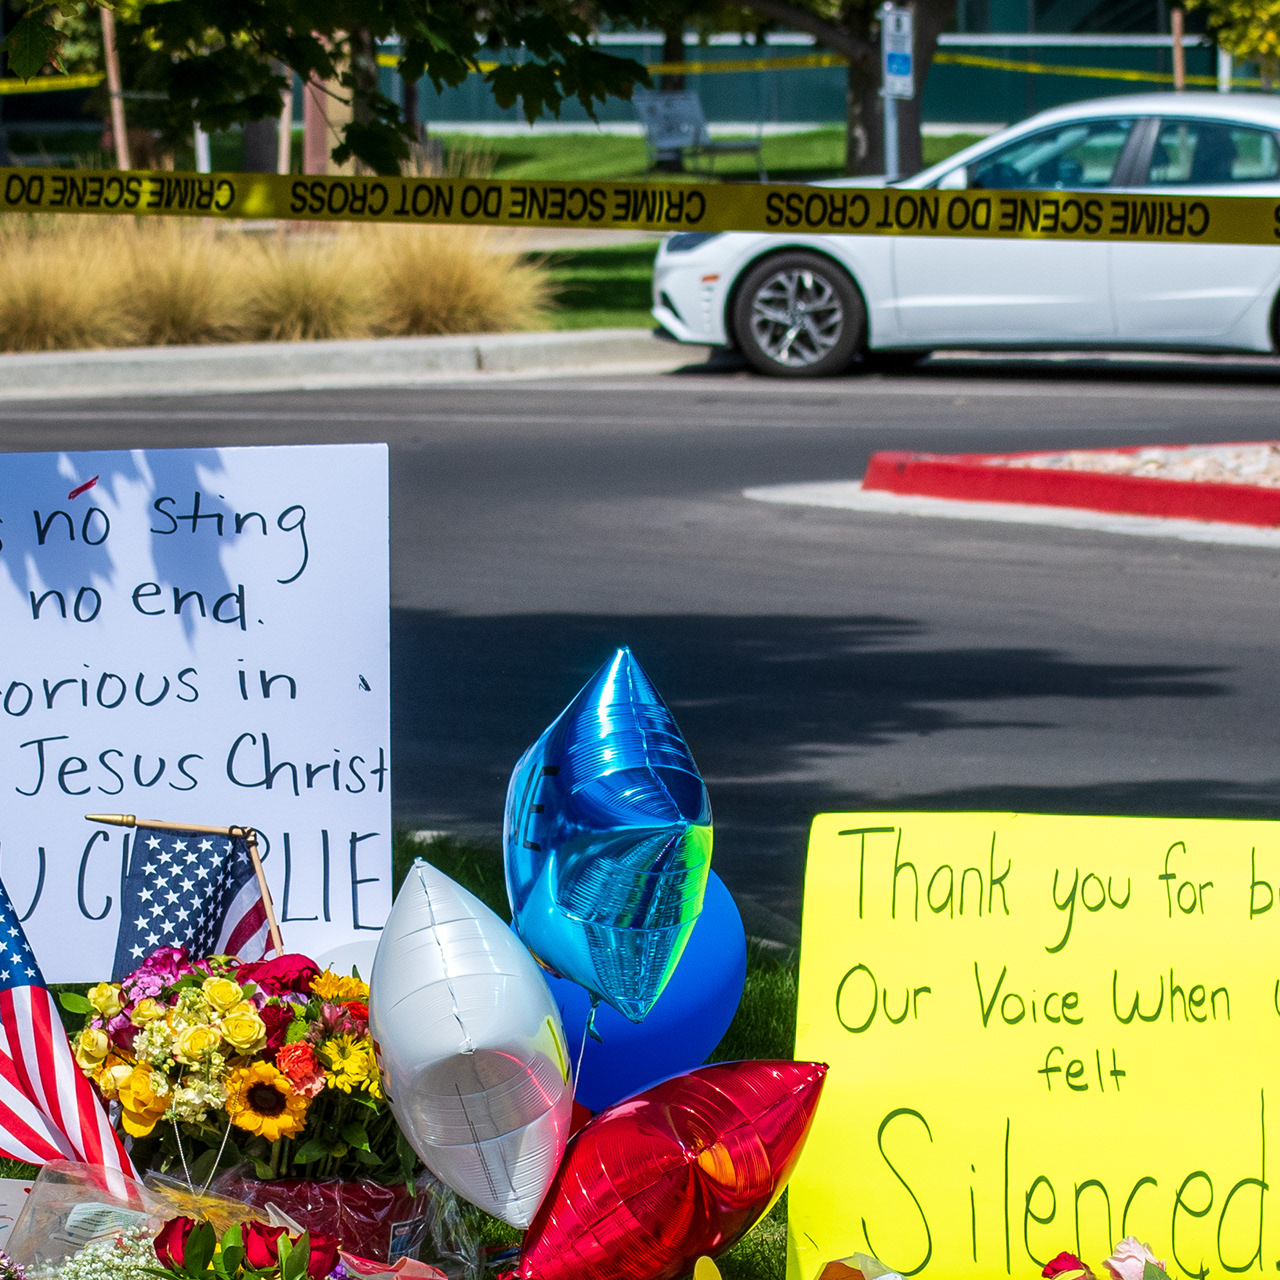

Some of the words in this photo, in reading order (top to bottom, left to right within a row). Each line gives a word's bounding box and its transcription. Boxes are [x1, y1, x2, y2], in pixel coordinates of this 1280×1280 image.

[5, 174, 44, 206] DO
[52, 176, 140, 207] SCENE
[142, 179, 235, 210] CRIME
[290, 181, 388, 215] CROSS
[394, 184, 453, 216] NOT
[461, 185, 502, 218] DO
[509, 187, 607, 222] SCENE
[612, 189, 706, 224] CRIME
[766, 192, 870, 227] CROSS
[876, 195, 939, 229] NOT
[947, 196, 991, 231] DO
[999, 197, 1104, 234] SCENE
[1110, 200, 1210, 236] CRIME
[29, 500, 110, 553] no
[149, 492, 308, 584] sting
[25, 579, 101, 622] no
[132, 574, 264, 633] end.
[238, 659, 296, 700] in
[15, 736, 203, 796] Jesus
[227, 733, 388, 796] Christ
[78, 828, 385, 931] CLIE
[838, 827, 1011, 922] Thank
[1045, 868, 1130, 954] you
[1158, 841, 1213, 918] for
[836, 963, 931, 1033] Our
[974, 962, 1083, 1028] Voice
[1113, 968, 1230, 1024] When
[1037, 1046, 1126, 1092] felt
